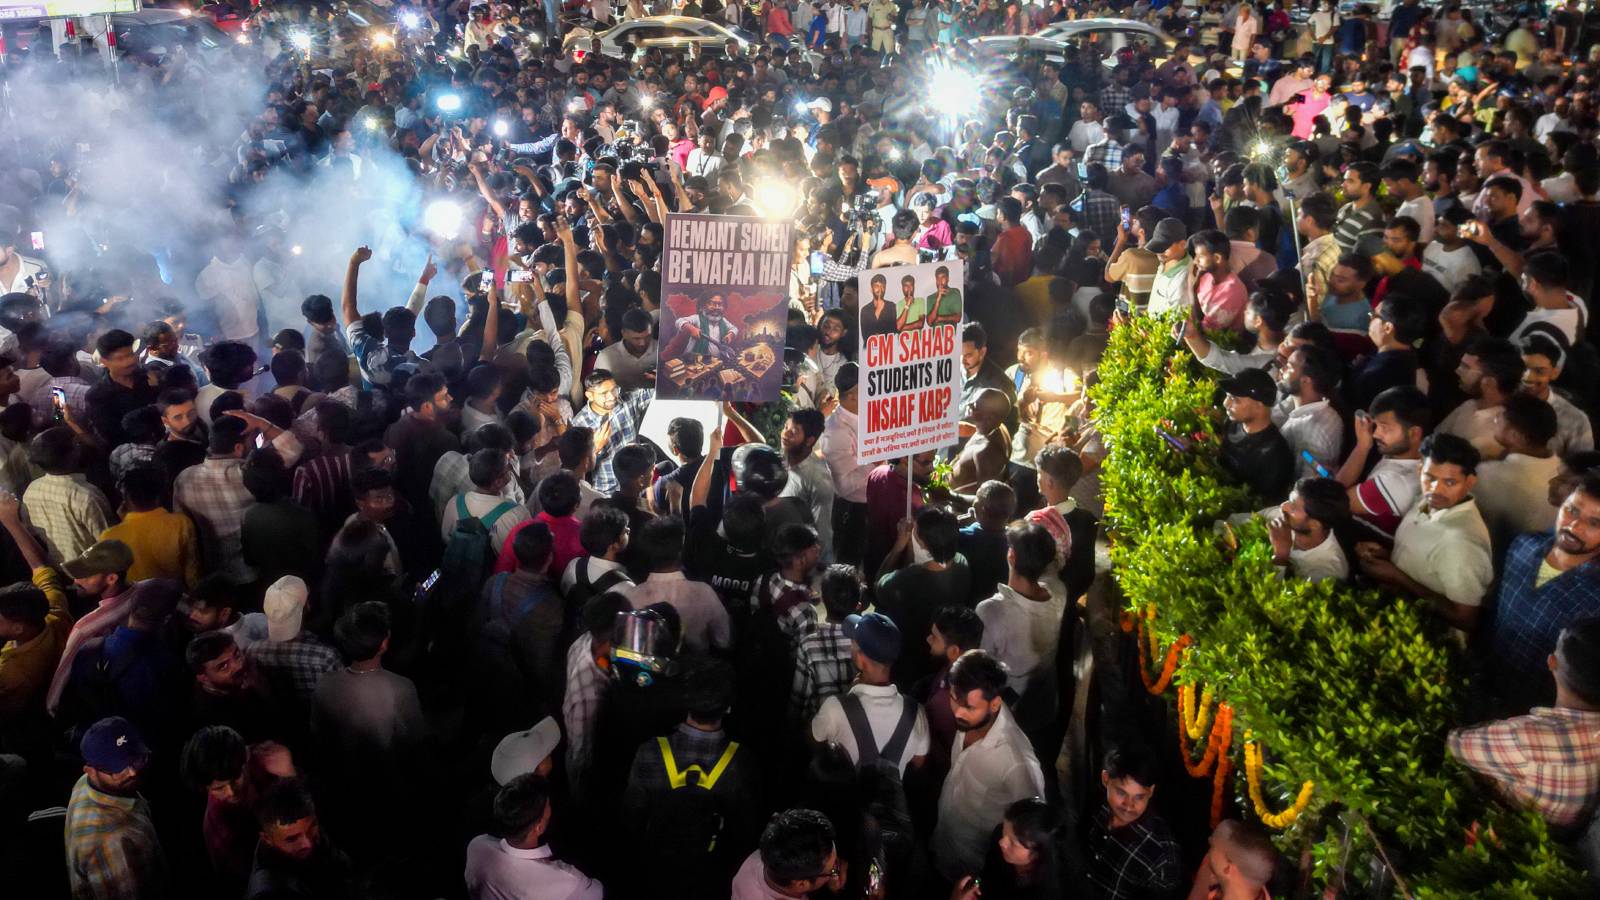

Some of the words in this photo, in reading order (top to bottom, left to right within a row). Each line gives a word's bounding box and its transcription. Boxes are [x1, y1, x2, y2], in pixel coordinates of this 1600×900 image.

[670, 219, 738, 251] HEMANT
[740, 222, 790, 252] SOREN
[668, 250, 755, 285] BEWAFAA
[758, 252, 788, 286] HAI
[866, 334, 894, 368] CM
[899, 324, 955, 363] SAHAB
[867, 361, 933, 397] STUDENTS
[936, 358, 952, 385] KO
[867, 393, 915, 434] INSAAF
[919, 386, 952, 423] KAB?
